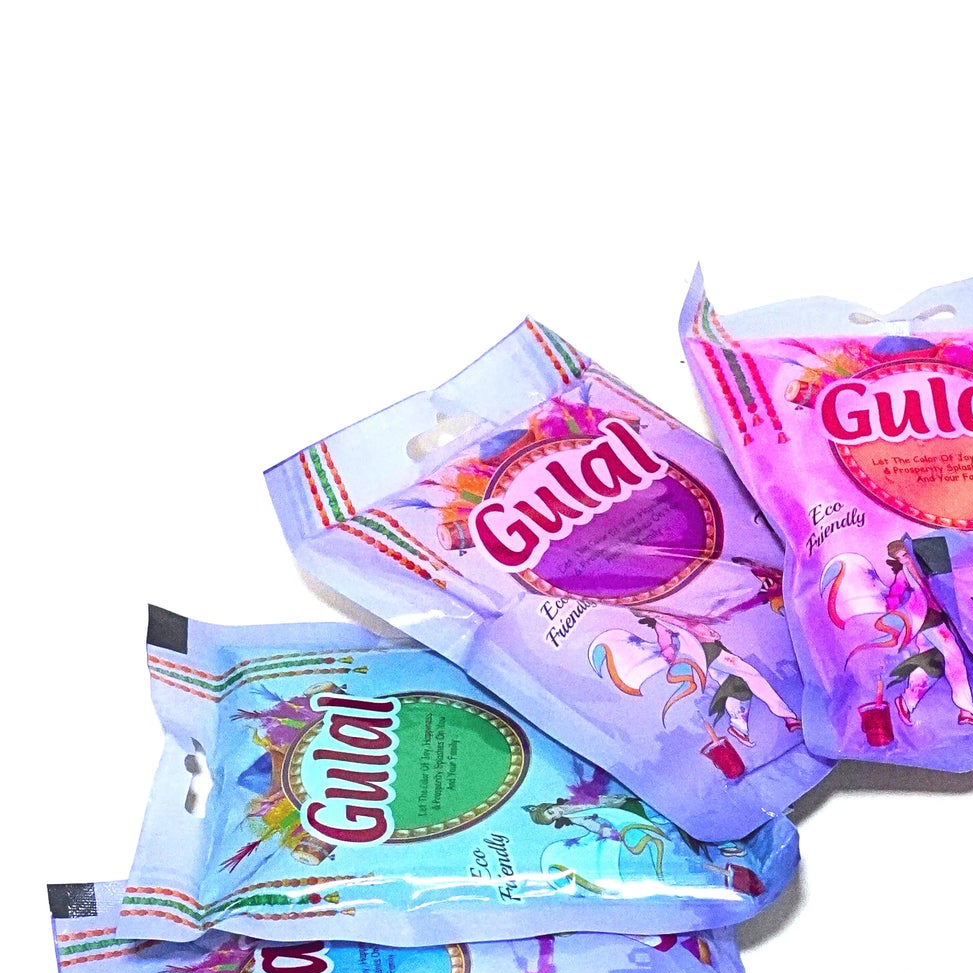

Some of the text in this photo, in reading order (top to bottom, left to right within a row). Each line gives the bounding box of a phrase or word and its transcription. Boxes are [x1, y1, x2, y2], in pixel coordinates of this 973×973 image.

[892, 456, 910, 464] The
[940, 454, 953, 462] Of
[893, 466, 943, 474] Prosperity
[938, 474, 959, 482] Your
[475, 421, 661, 566] Gulal
[808, 502, 844, 526] Eco
[806, 507, 866, 556] Friendly
[540, 595, 570, 620] Eco
[307, 696, 394, 843] Gulal
